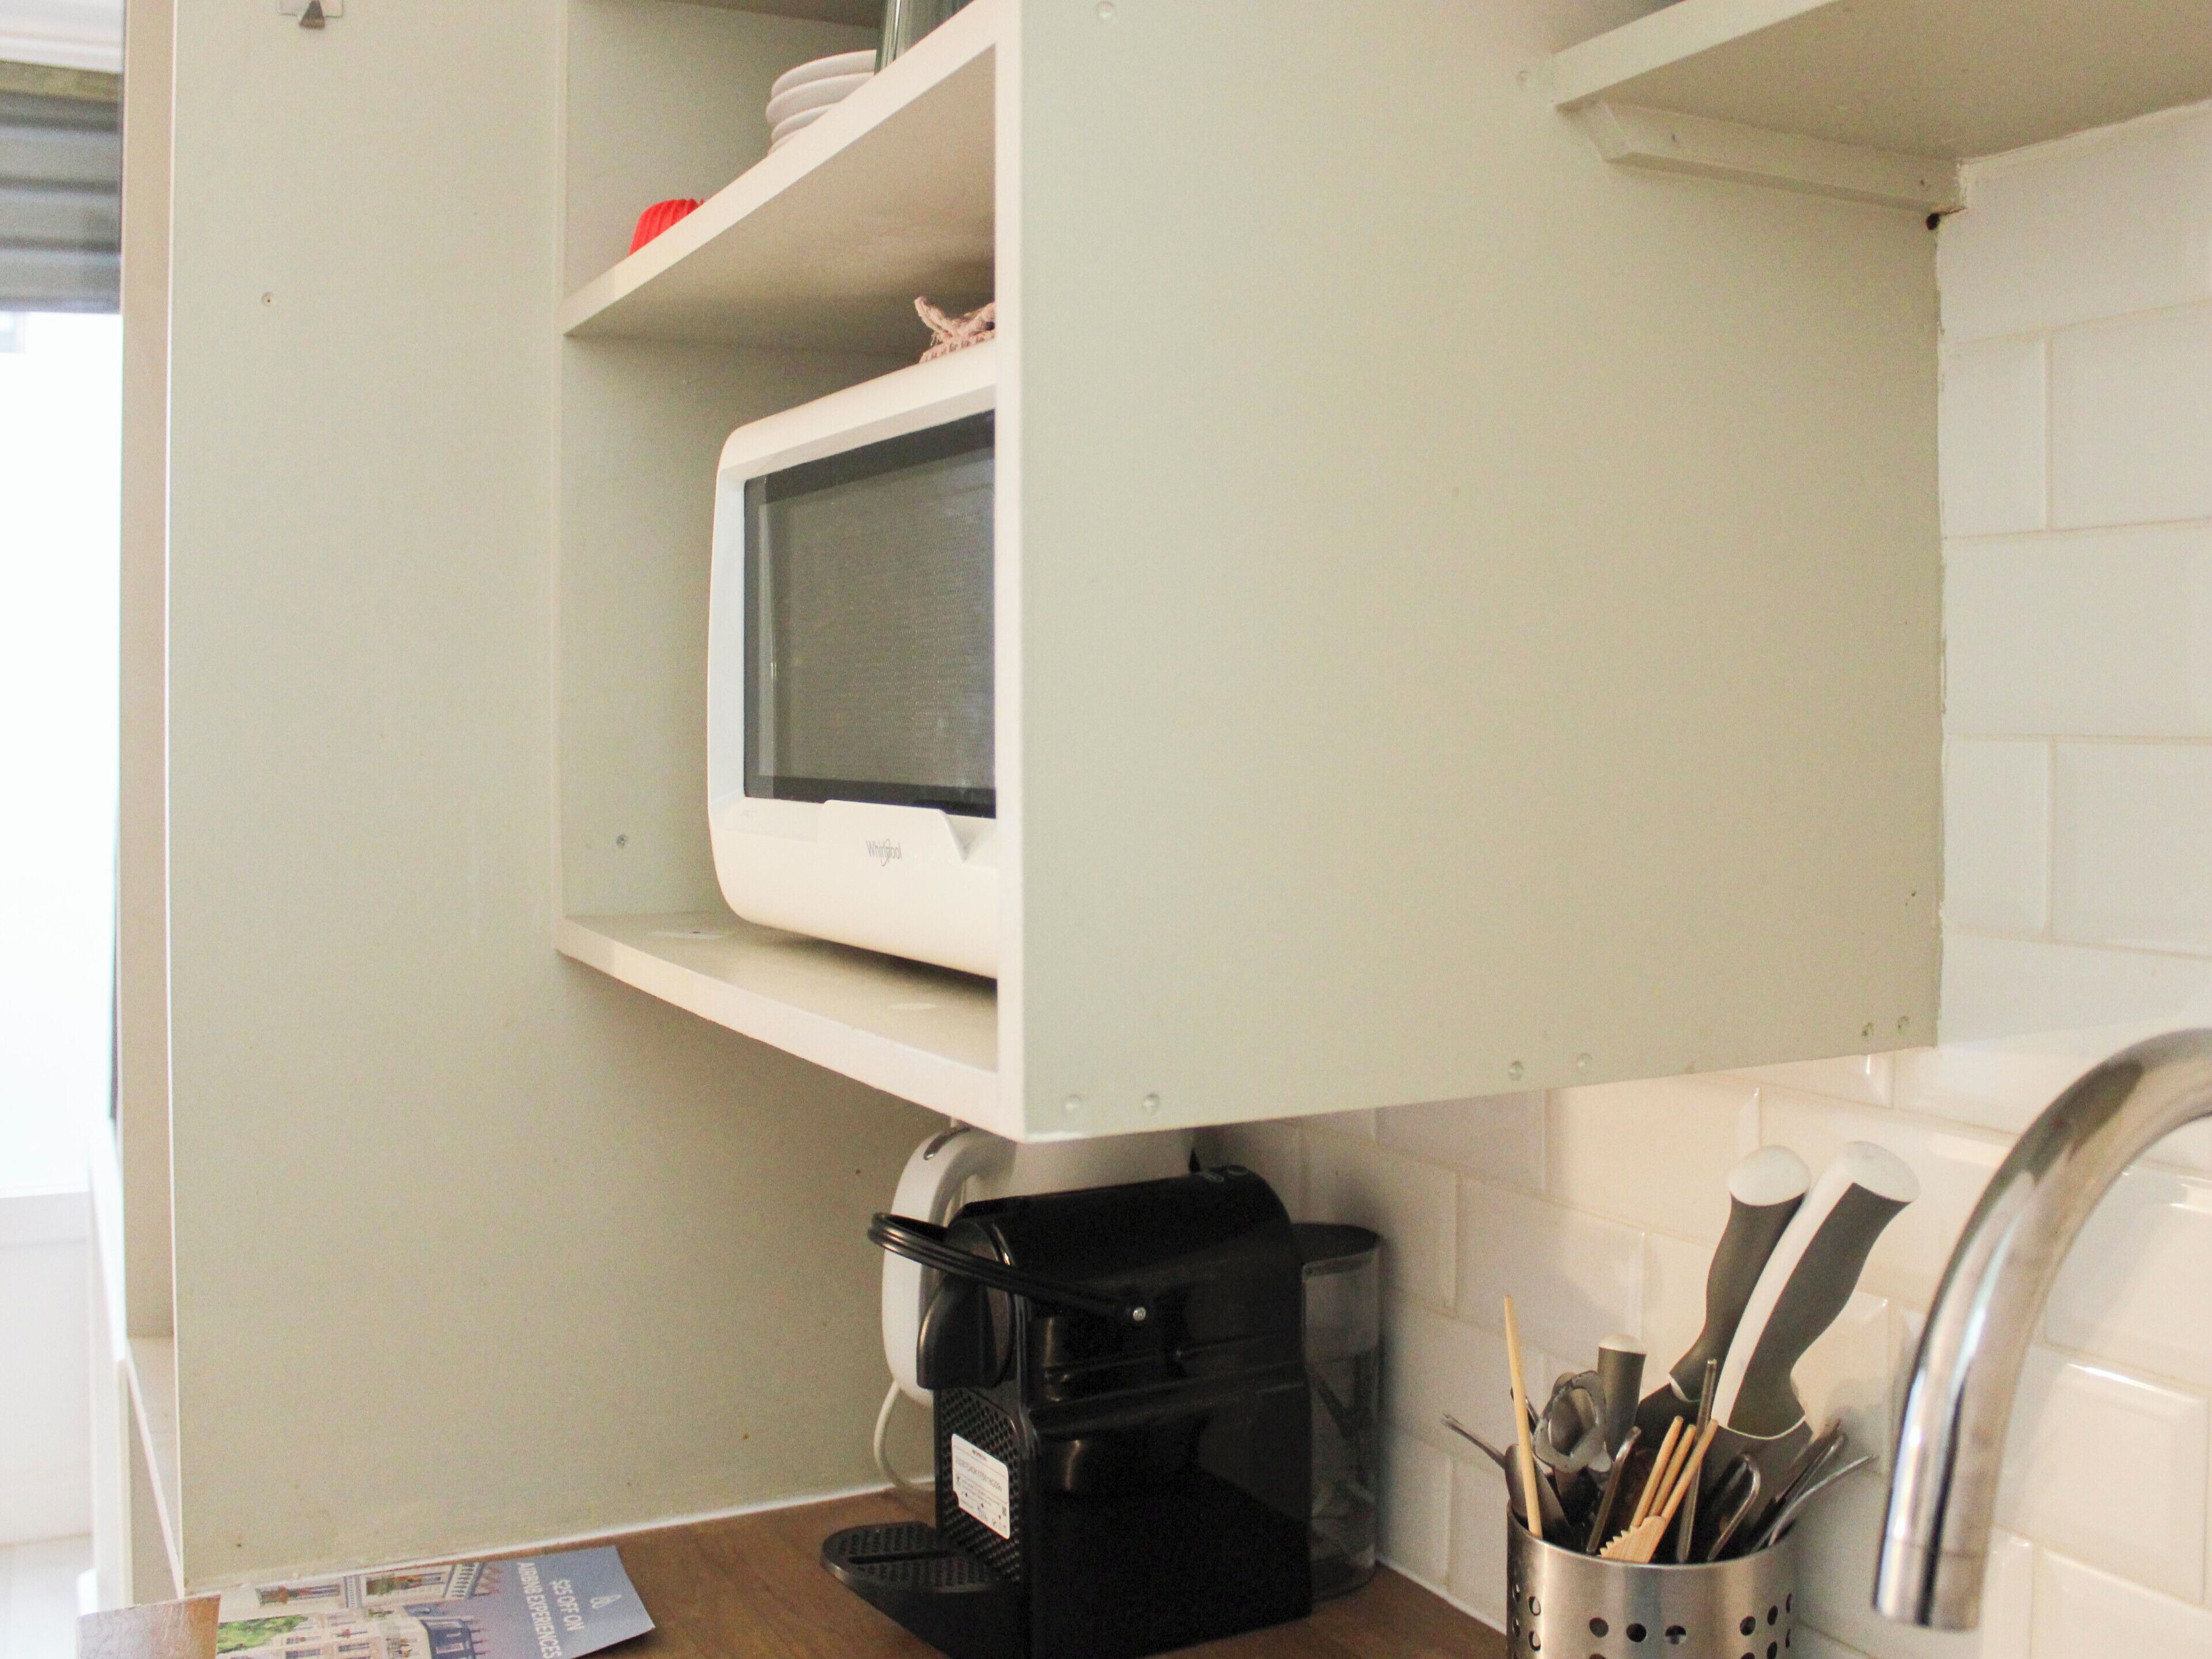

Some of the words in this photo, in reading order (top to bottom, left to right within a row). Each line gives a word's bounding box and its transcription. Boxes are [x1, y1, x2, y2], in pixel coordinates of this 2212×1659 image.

[866, 839, 903, 867] Whirlpool
[517, 1562, 543, 1595] AIRBNB
[550, 1579, 574, 1595] $25
[556, 1596, 580, 1613] OFF
[527, 1594, 562, 1659] EXPERIENCES
[563, 1614, 585, 1631] ON
